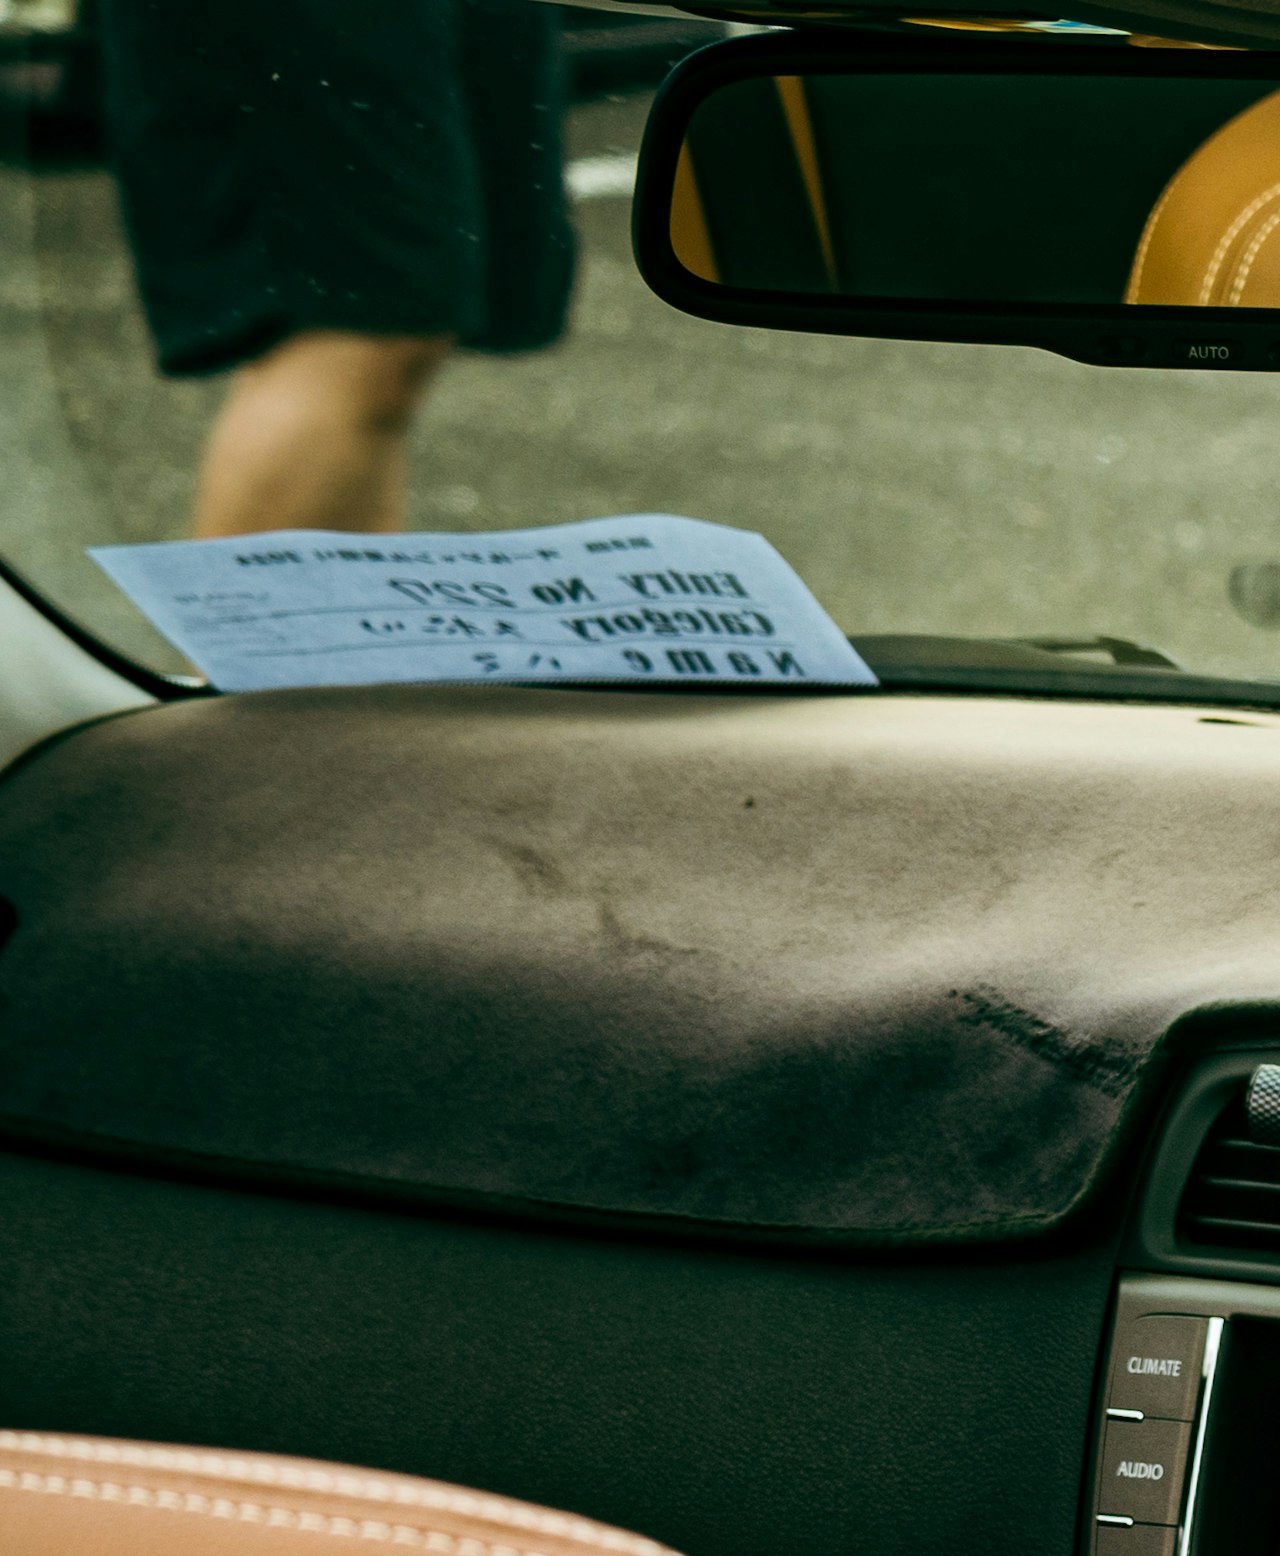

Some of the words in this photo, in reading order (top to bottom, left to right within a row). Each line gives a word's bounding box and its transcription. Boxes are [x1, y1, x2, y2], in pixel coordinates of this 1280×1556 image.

[1188, 345, 1230, 360] AUTO
[1126, 1355, 1184, 1378] CLIMATE
[1116, 1460, 1165, 1483] AUDIO
